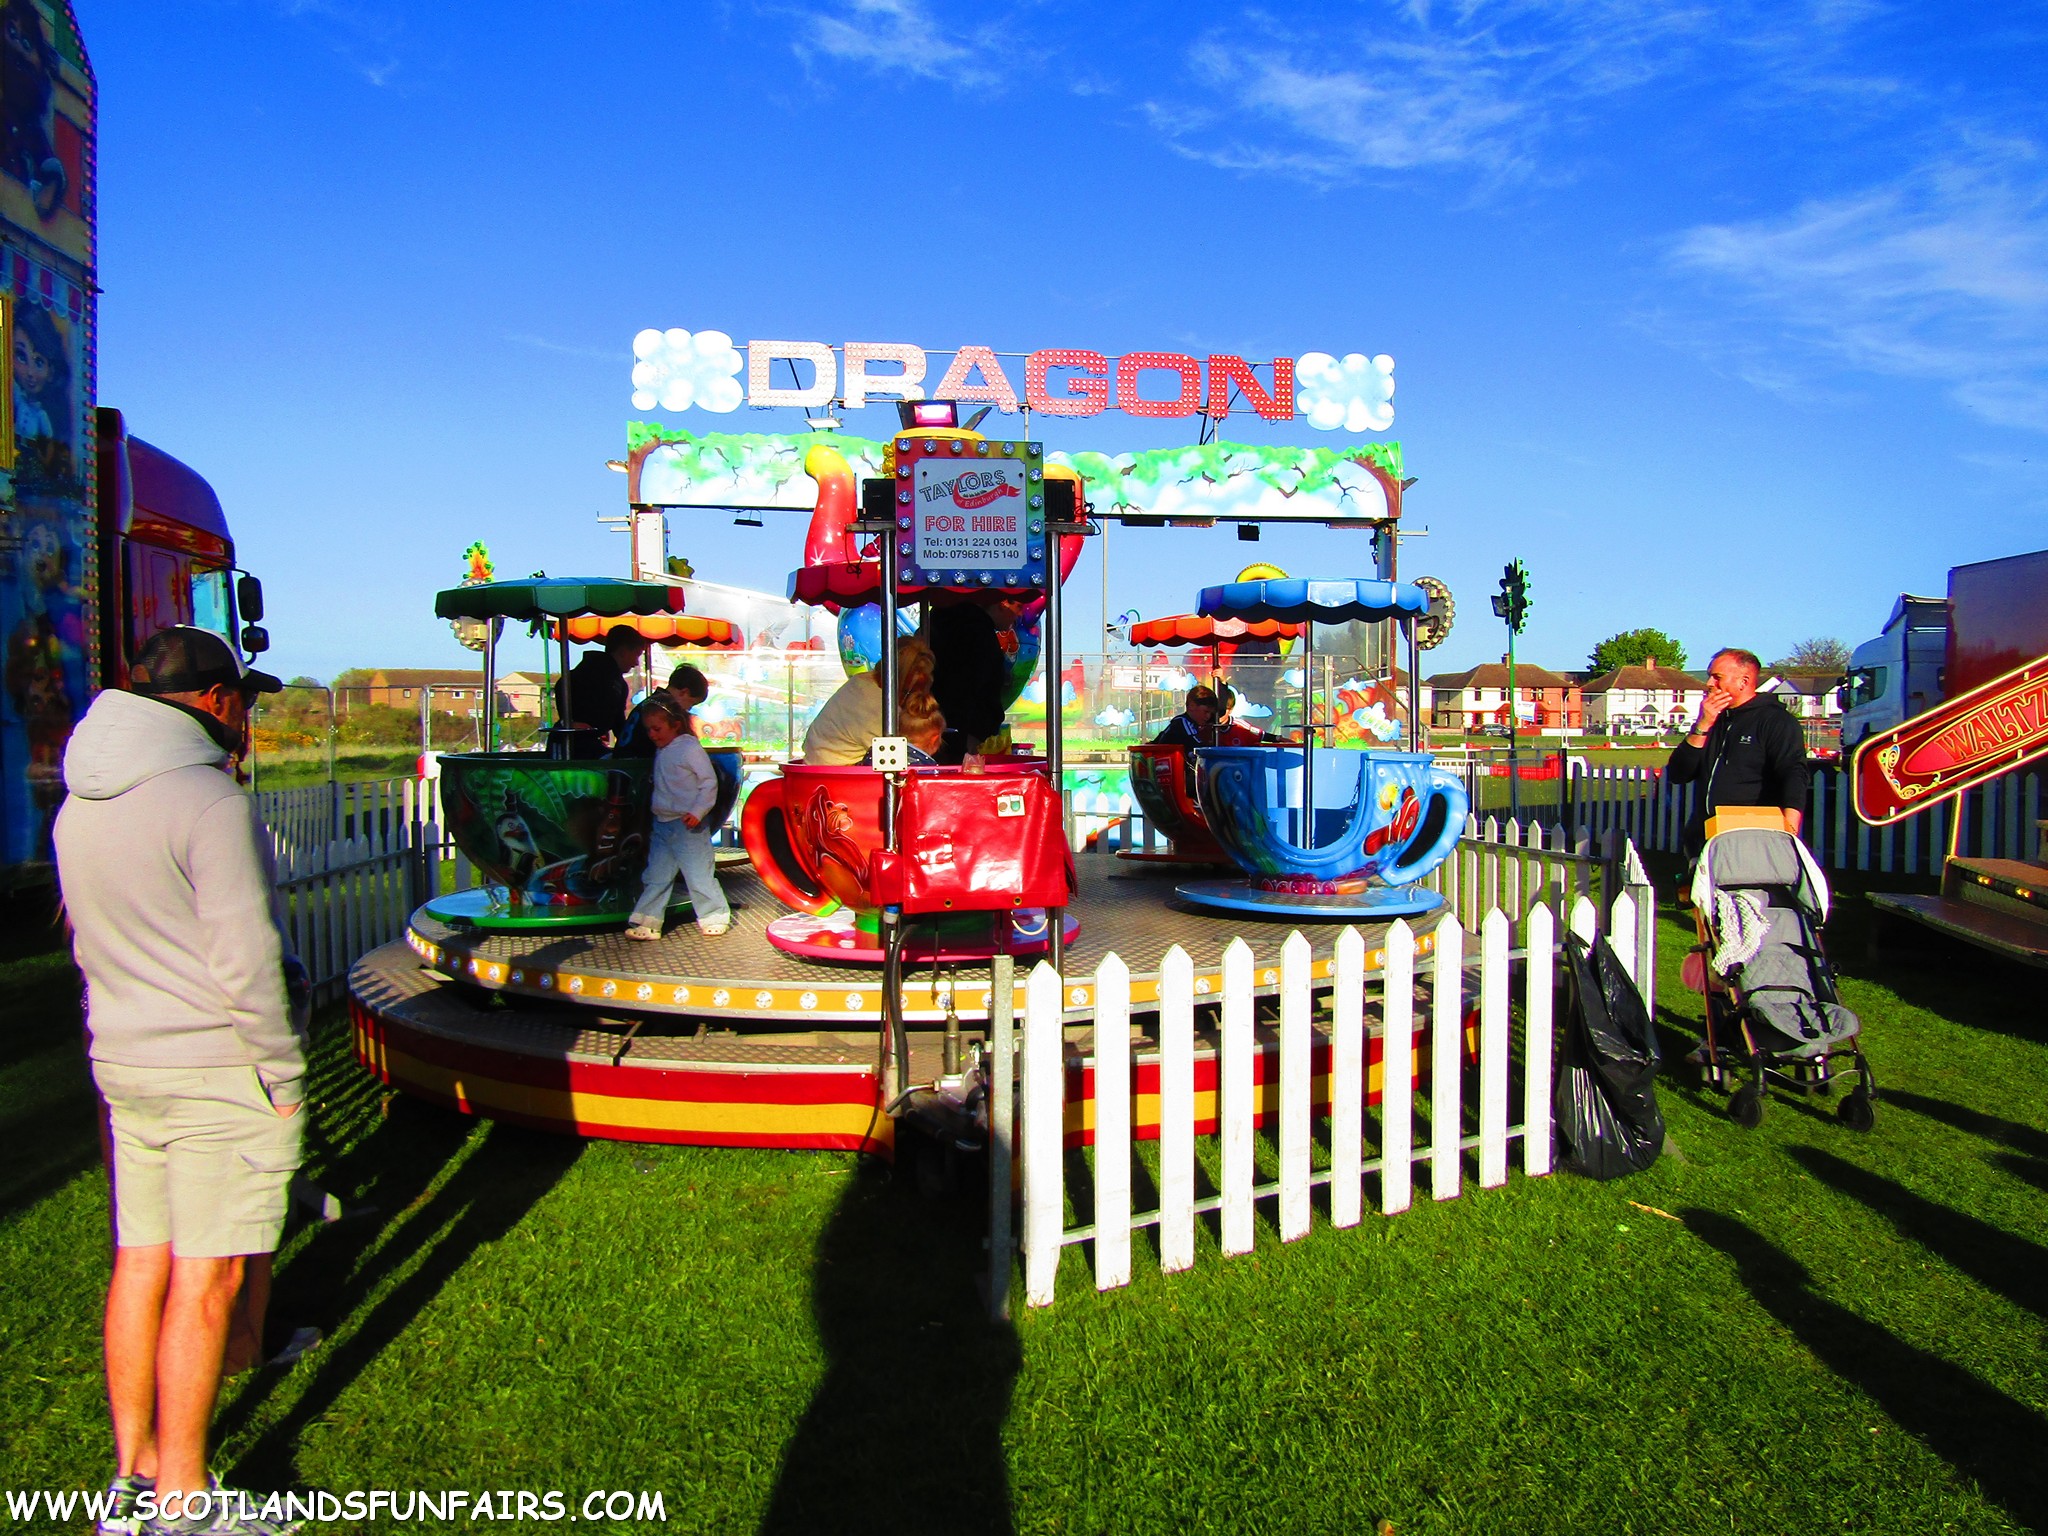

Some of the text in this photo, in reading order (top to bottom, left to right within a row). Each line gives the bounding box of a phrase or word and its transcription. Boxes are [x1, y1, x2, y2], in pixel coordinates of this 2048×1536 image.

[748, 340, 1294, 420] DRAGON
[918, 469, 1006, 502] TAYLORS
[964, 488, 1003, 508] Edinburgh
[925, 515, 1017, 532] FOR HIRE
[924, 537, 1018, 547] Tel: 0131 224 0304
[923, 549, 1019, 559] Mob: 07968 715 140
